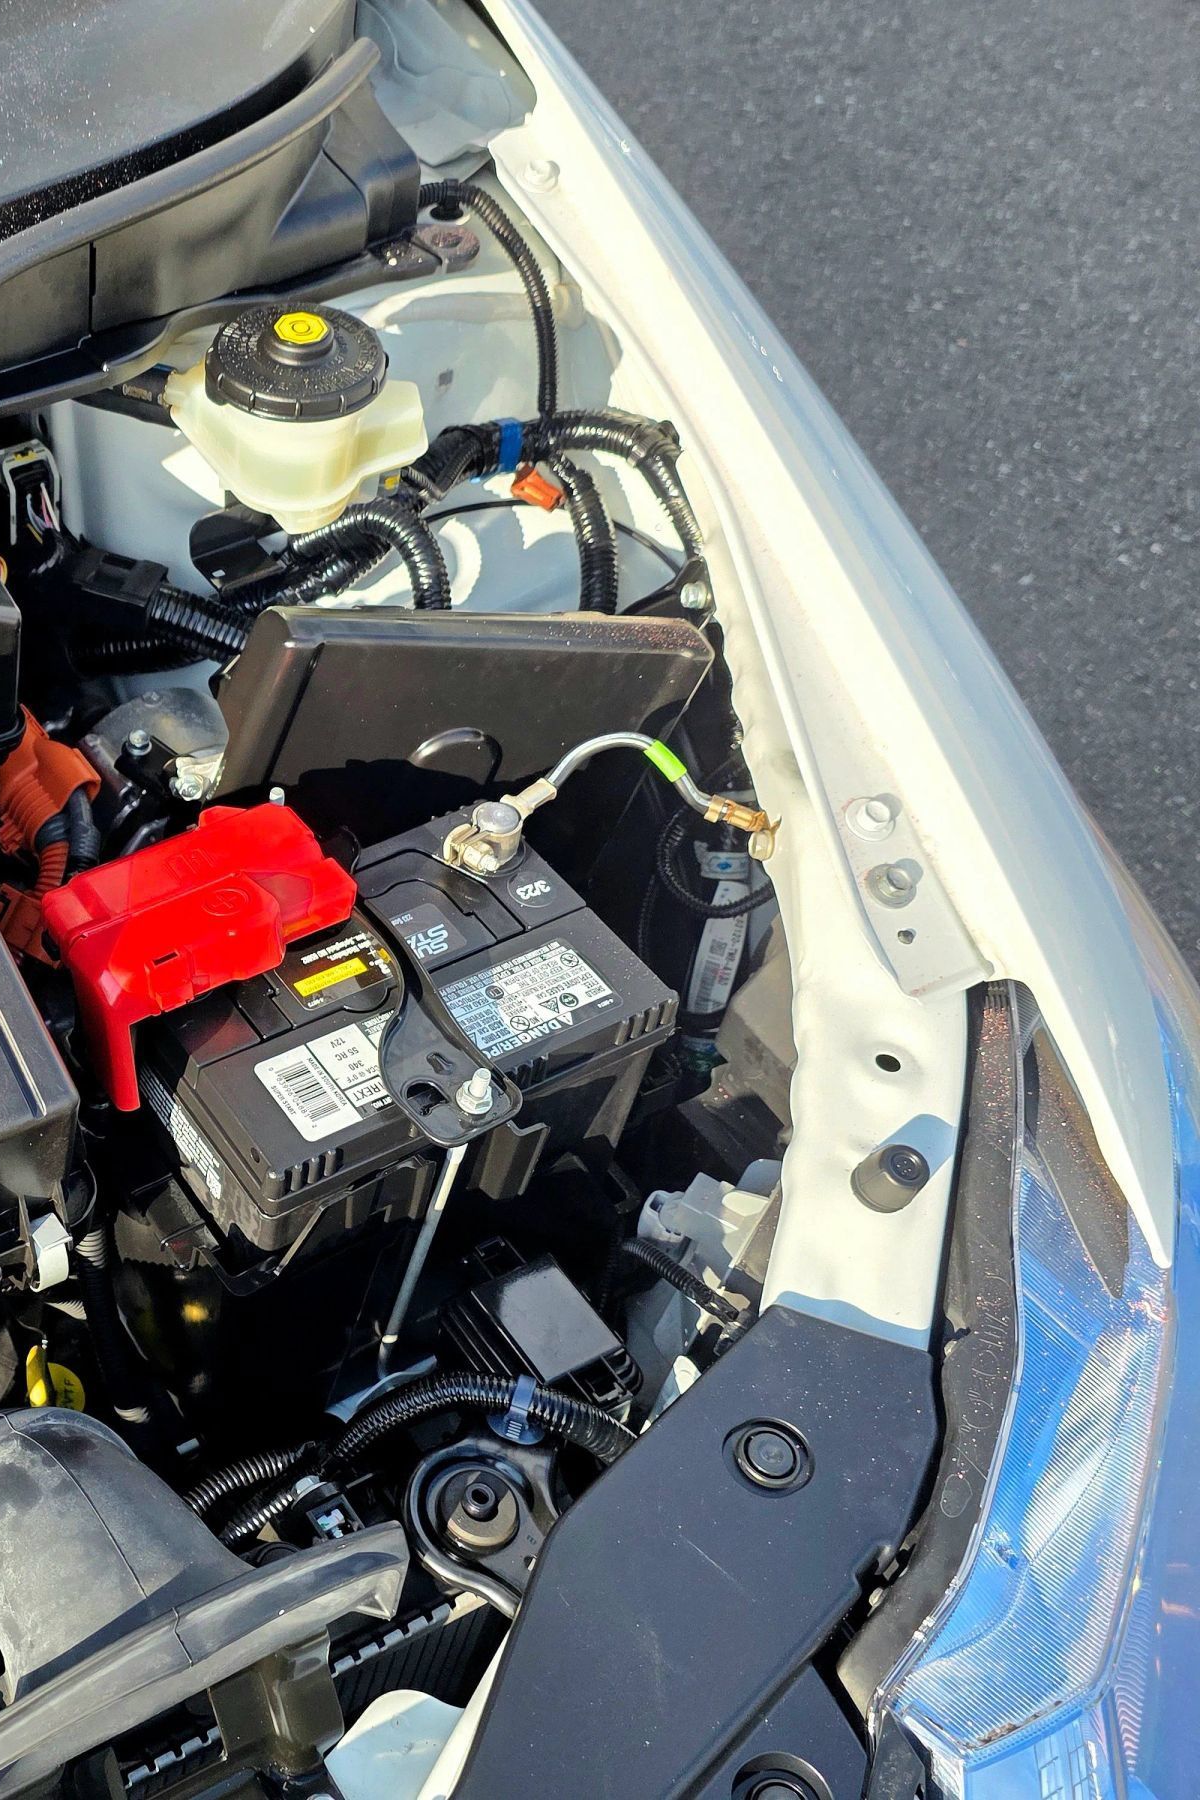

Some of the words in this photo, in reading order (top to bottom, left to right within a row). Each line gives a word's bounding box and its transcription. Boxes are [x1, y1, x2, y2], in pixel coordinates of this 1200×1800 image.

[515, 879, 551, 900] 3/23
[404, 923, 448, 949] STA
[536, 971, 549, 979] OUT
[535, 991, 547, 999] CAN
[584, 985, 605, 997] SHIELD
[472, 997, 489, 1007] READ
[464, 1011, 484, 1023] SEVERE
[478, 1014, 497, 1025] CAUSE
[528, 1016, 539, 1024] NO
[477, 1027, 490, 1035] CAN
[487, 1020, 505, 1031] ACID
[480, 1027, 511, 1044] SULFURIC
[329, 1037, 345, 1047] 12V
[334, 1051, 347, 1061] RC
[347, 1046, 358, 1055] 55
[348, 1059, 364, 1070] 340
[307, 1057, 318, 1069] MADE
[321, 1075, 334, 1090] SOUTH
[333, 1090, 347, 1105] KOREA
[271, 1085, 286, 1101] SUPER
[282, 1100, 296, 1115] START
